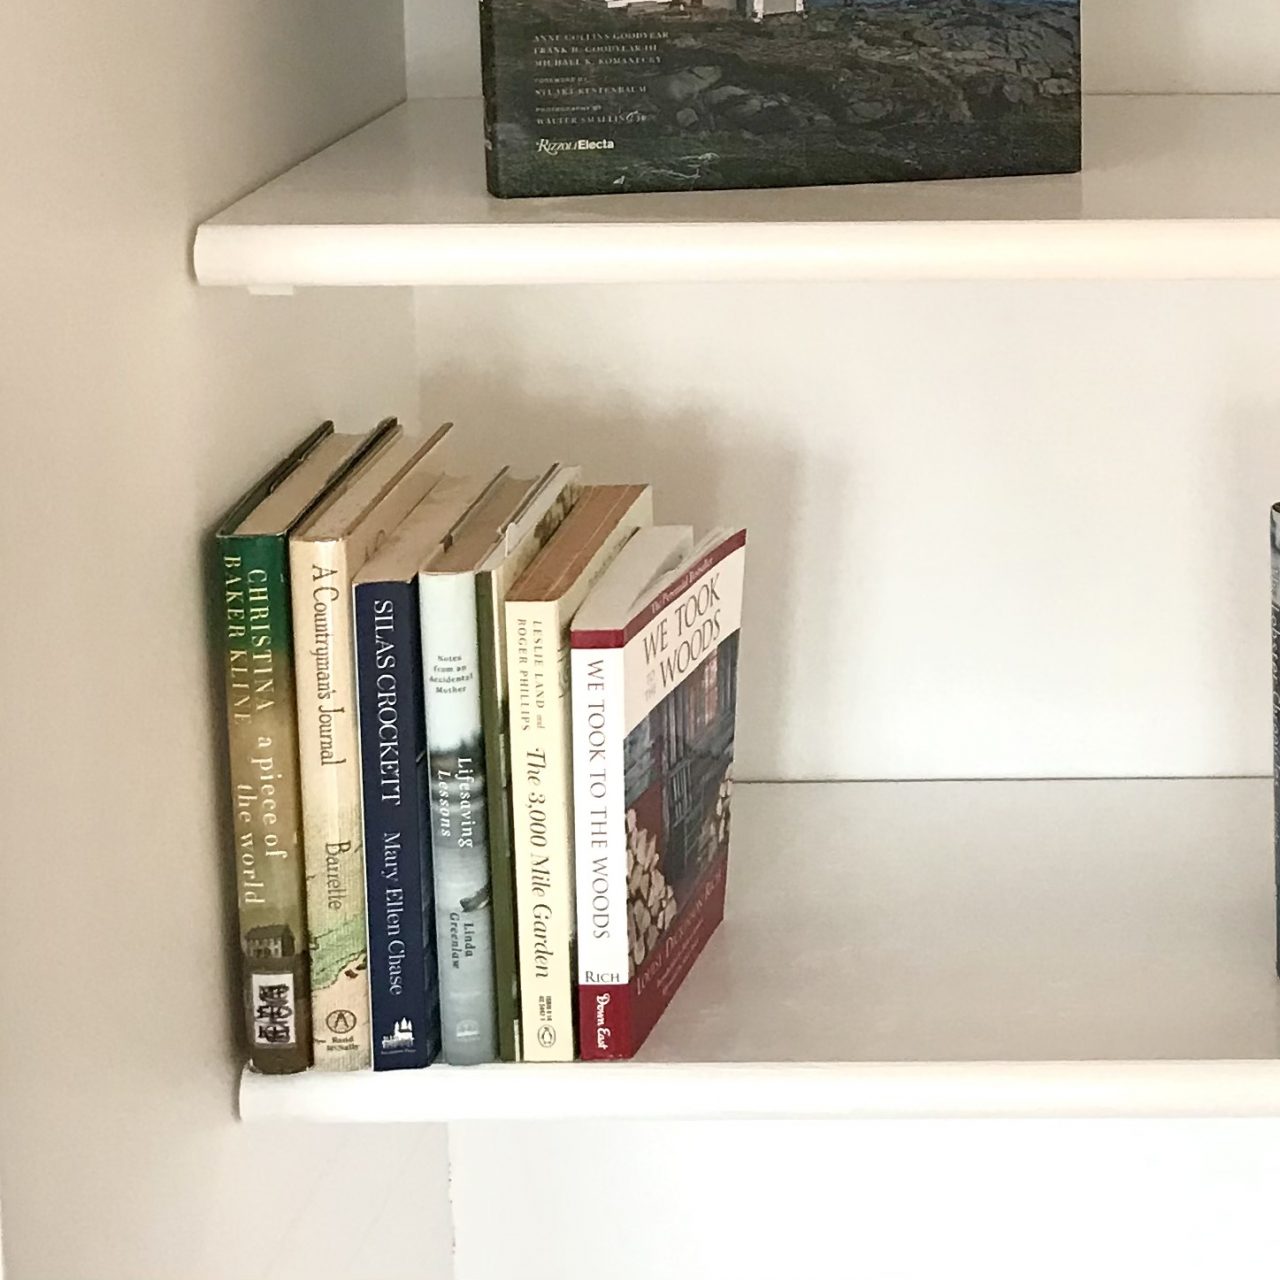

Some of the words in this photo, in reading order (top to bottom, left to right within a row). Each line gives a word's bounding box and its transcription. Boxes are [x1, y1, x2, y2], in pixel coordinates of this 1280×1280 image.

[223, 556, 247, 639] BAKER
[312, 565, 338, 582] A
[247, 569, 276, 712] CHRISTINA
[309, 585, 340, 701] Countryman's
[374, 600, 395, 670] SILAS
[517, 618, 528, 664] ROGER
[532, 620, 545, 664] LESLIE
[643, 617, 668, 665] WE
[674, 572, 721, 637] TOOK
[437, 655, 463, 663] Notes
[587, 659, 605, 692] WE
[659, 608, 721, 688] WOODS
[229, 650, 253, 726] KLINE
[435, 686, 467, 695] Mother
[519, 670, 531, 732] PHILLIPS
[534, 672, 545, 709] LAND
[258, 736, 273, 748] a
[318, 704, 347, 767] Journal
[376, 674, 402, 807] CROCKETT
[588, 701, 606, 763] TOOK
[251, 756, 283, 826] piece
[526, 747, 547, 786] The
[589, 772, 607, 799] TO
[236, 784, 259, 824] the
[437, 769, 452, 838] Lessons
[456, 756, 477, 849] Lifesaving
[527, 790, 549, 848] 3,000
[590, 809, 608, 849] THE
[240, 831, 267, 905] world
[264, 833, 289, 859] of
[381, 832, 402, 880] Mary
[530, 853, 551, 897] Mile
[591, 857, 611, 940] WOODS
[384, 888, 404, 937] Ellen
[449, 912, 462, 970] Greenlaw
[463, 922, 476, 958] Linda
[532, 903, 554, 979] Garden
[386, 939, 407, 996] Chase
[596, 992, 611, 1026] Down
[597, 1026, 612, 1051] East
